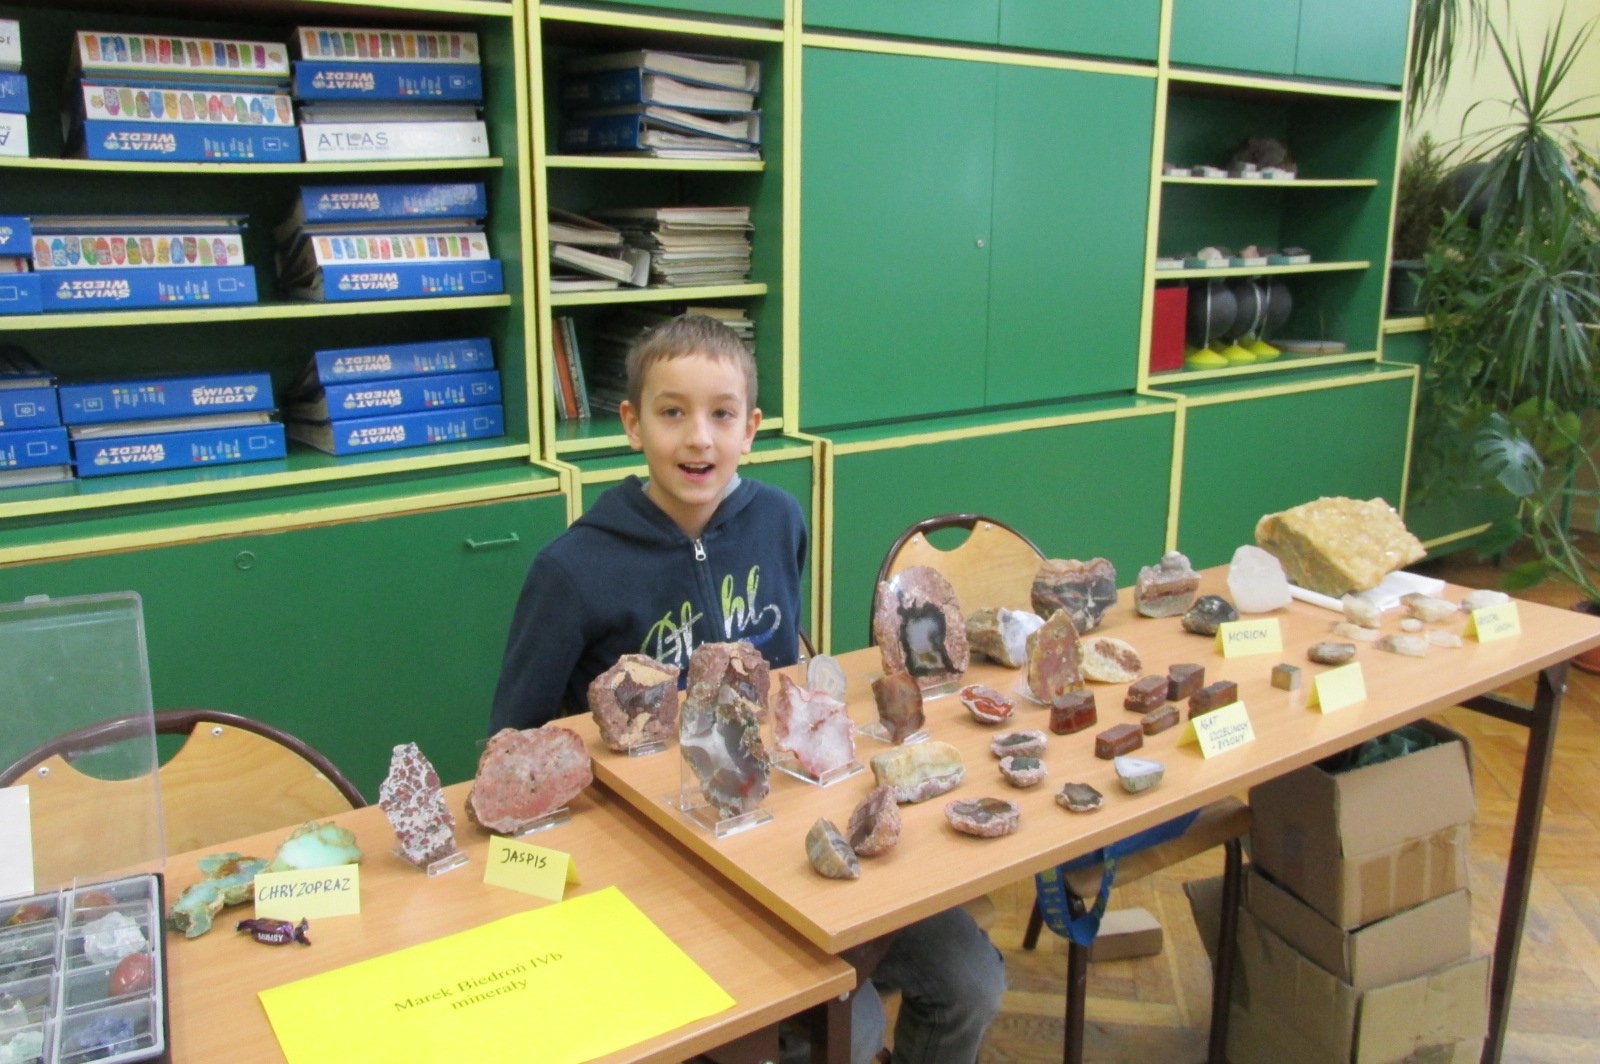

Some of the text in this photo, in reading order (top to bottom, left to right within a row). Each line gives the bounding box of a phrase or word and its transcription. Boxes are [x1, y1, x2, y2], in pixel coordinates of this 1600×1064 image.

[314, 71, 374, 82] WIEDZY
[107, 132, 175, 143] WIEDZY
[318, 131, 389, 147] ATLAS
[340, 272, 398, 283] WIEDZY
[59, 279, 129, 291] WIEDZY
[193, 394, 255, 405] WIEDZY
[344, 388, 401, 402] WIEDZY
[350, 424, 405, 437] WIEDZY
[97, 443, 164, 457] WIEDZY
[1228, 629, 1268, 643] MORION
[500, 847, 548, 870] JASPIS
[258, 877, 351, 901] CHRYZOPRAZ
[394, 987, 453, 1013] Marek
[530, 952, 563, 969] IVb
[451, 979, 528, 1010] minerały
